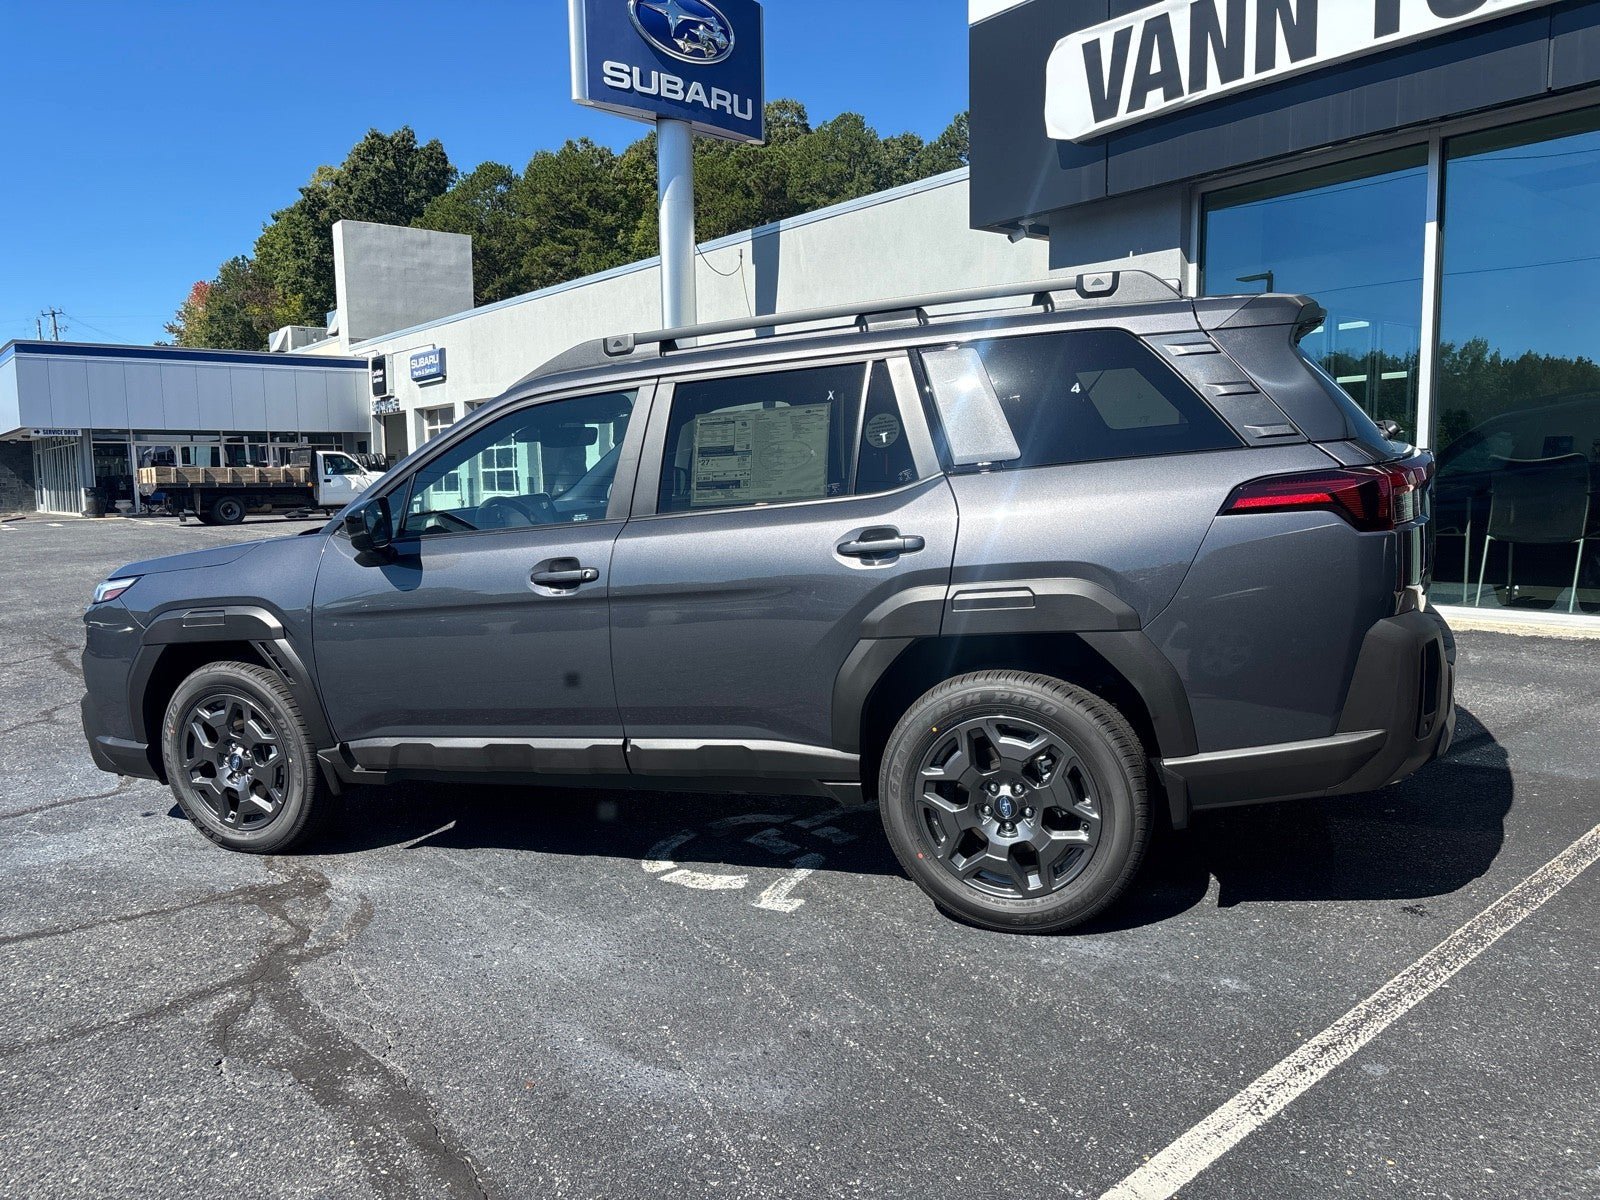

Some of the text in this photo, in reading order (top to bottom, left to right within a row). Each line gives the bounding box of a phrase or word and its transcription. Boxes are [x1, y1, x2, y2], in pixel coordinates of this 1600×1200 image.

[1082, 0, 1318, 124] VANN
[602, 60, 753, 121] SUBARU
[411, 354, 438, 368] SUBARU
[1070, 382, 1081, 394] 4
[827, 390, 835, 401] X
[879, 431, 888, 443] T
[994, 691, 1059, 717] PT20
